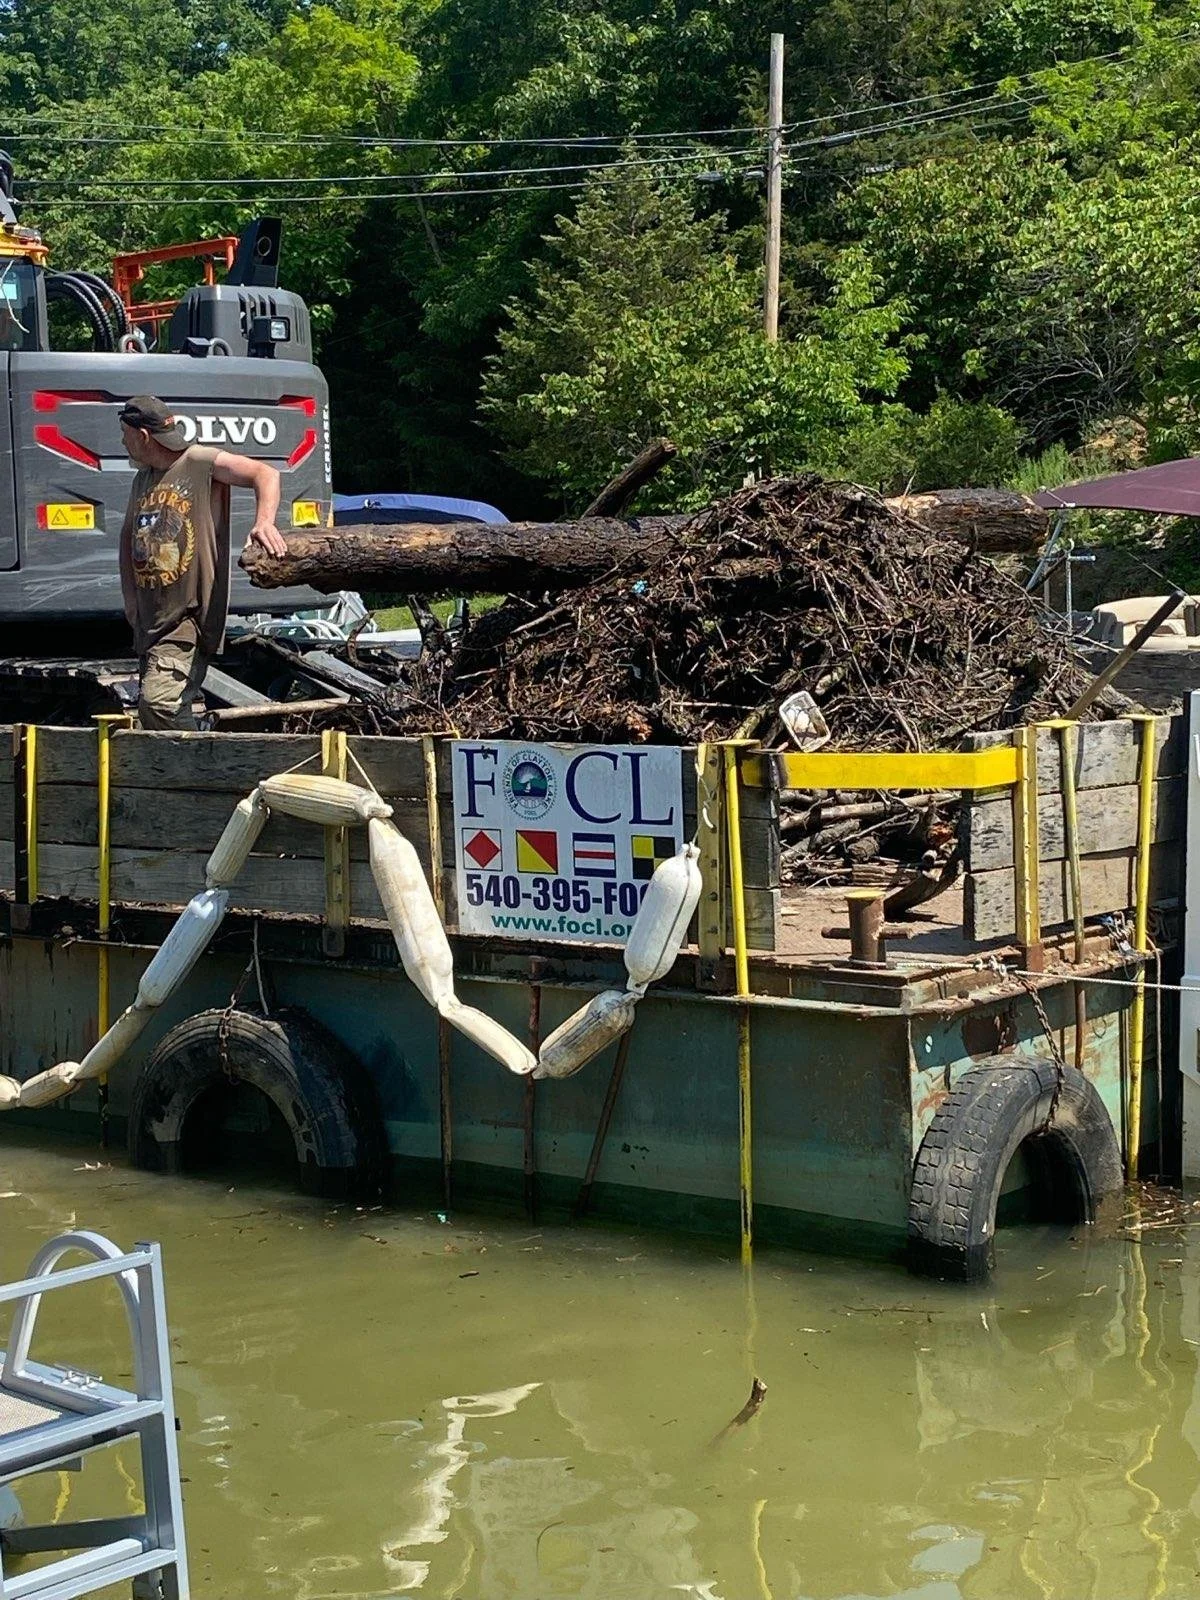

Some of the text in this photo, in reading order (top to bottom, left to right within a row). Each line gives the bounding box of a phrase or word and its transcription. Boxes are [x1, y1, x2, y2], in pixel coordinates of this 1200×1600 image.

[173, 415, 277, 445] OLVO
[137, 490, 192, 514] OLORS
[511, 755, 521, 767] OF
[522, 753, 553, 781] CLAYTOR
[504, 767, 519, 809] FRIENDS
